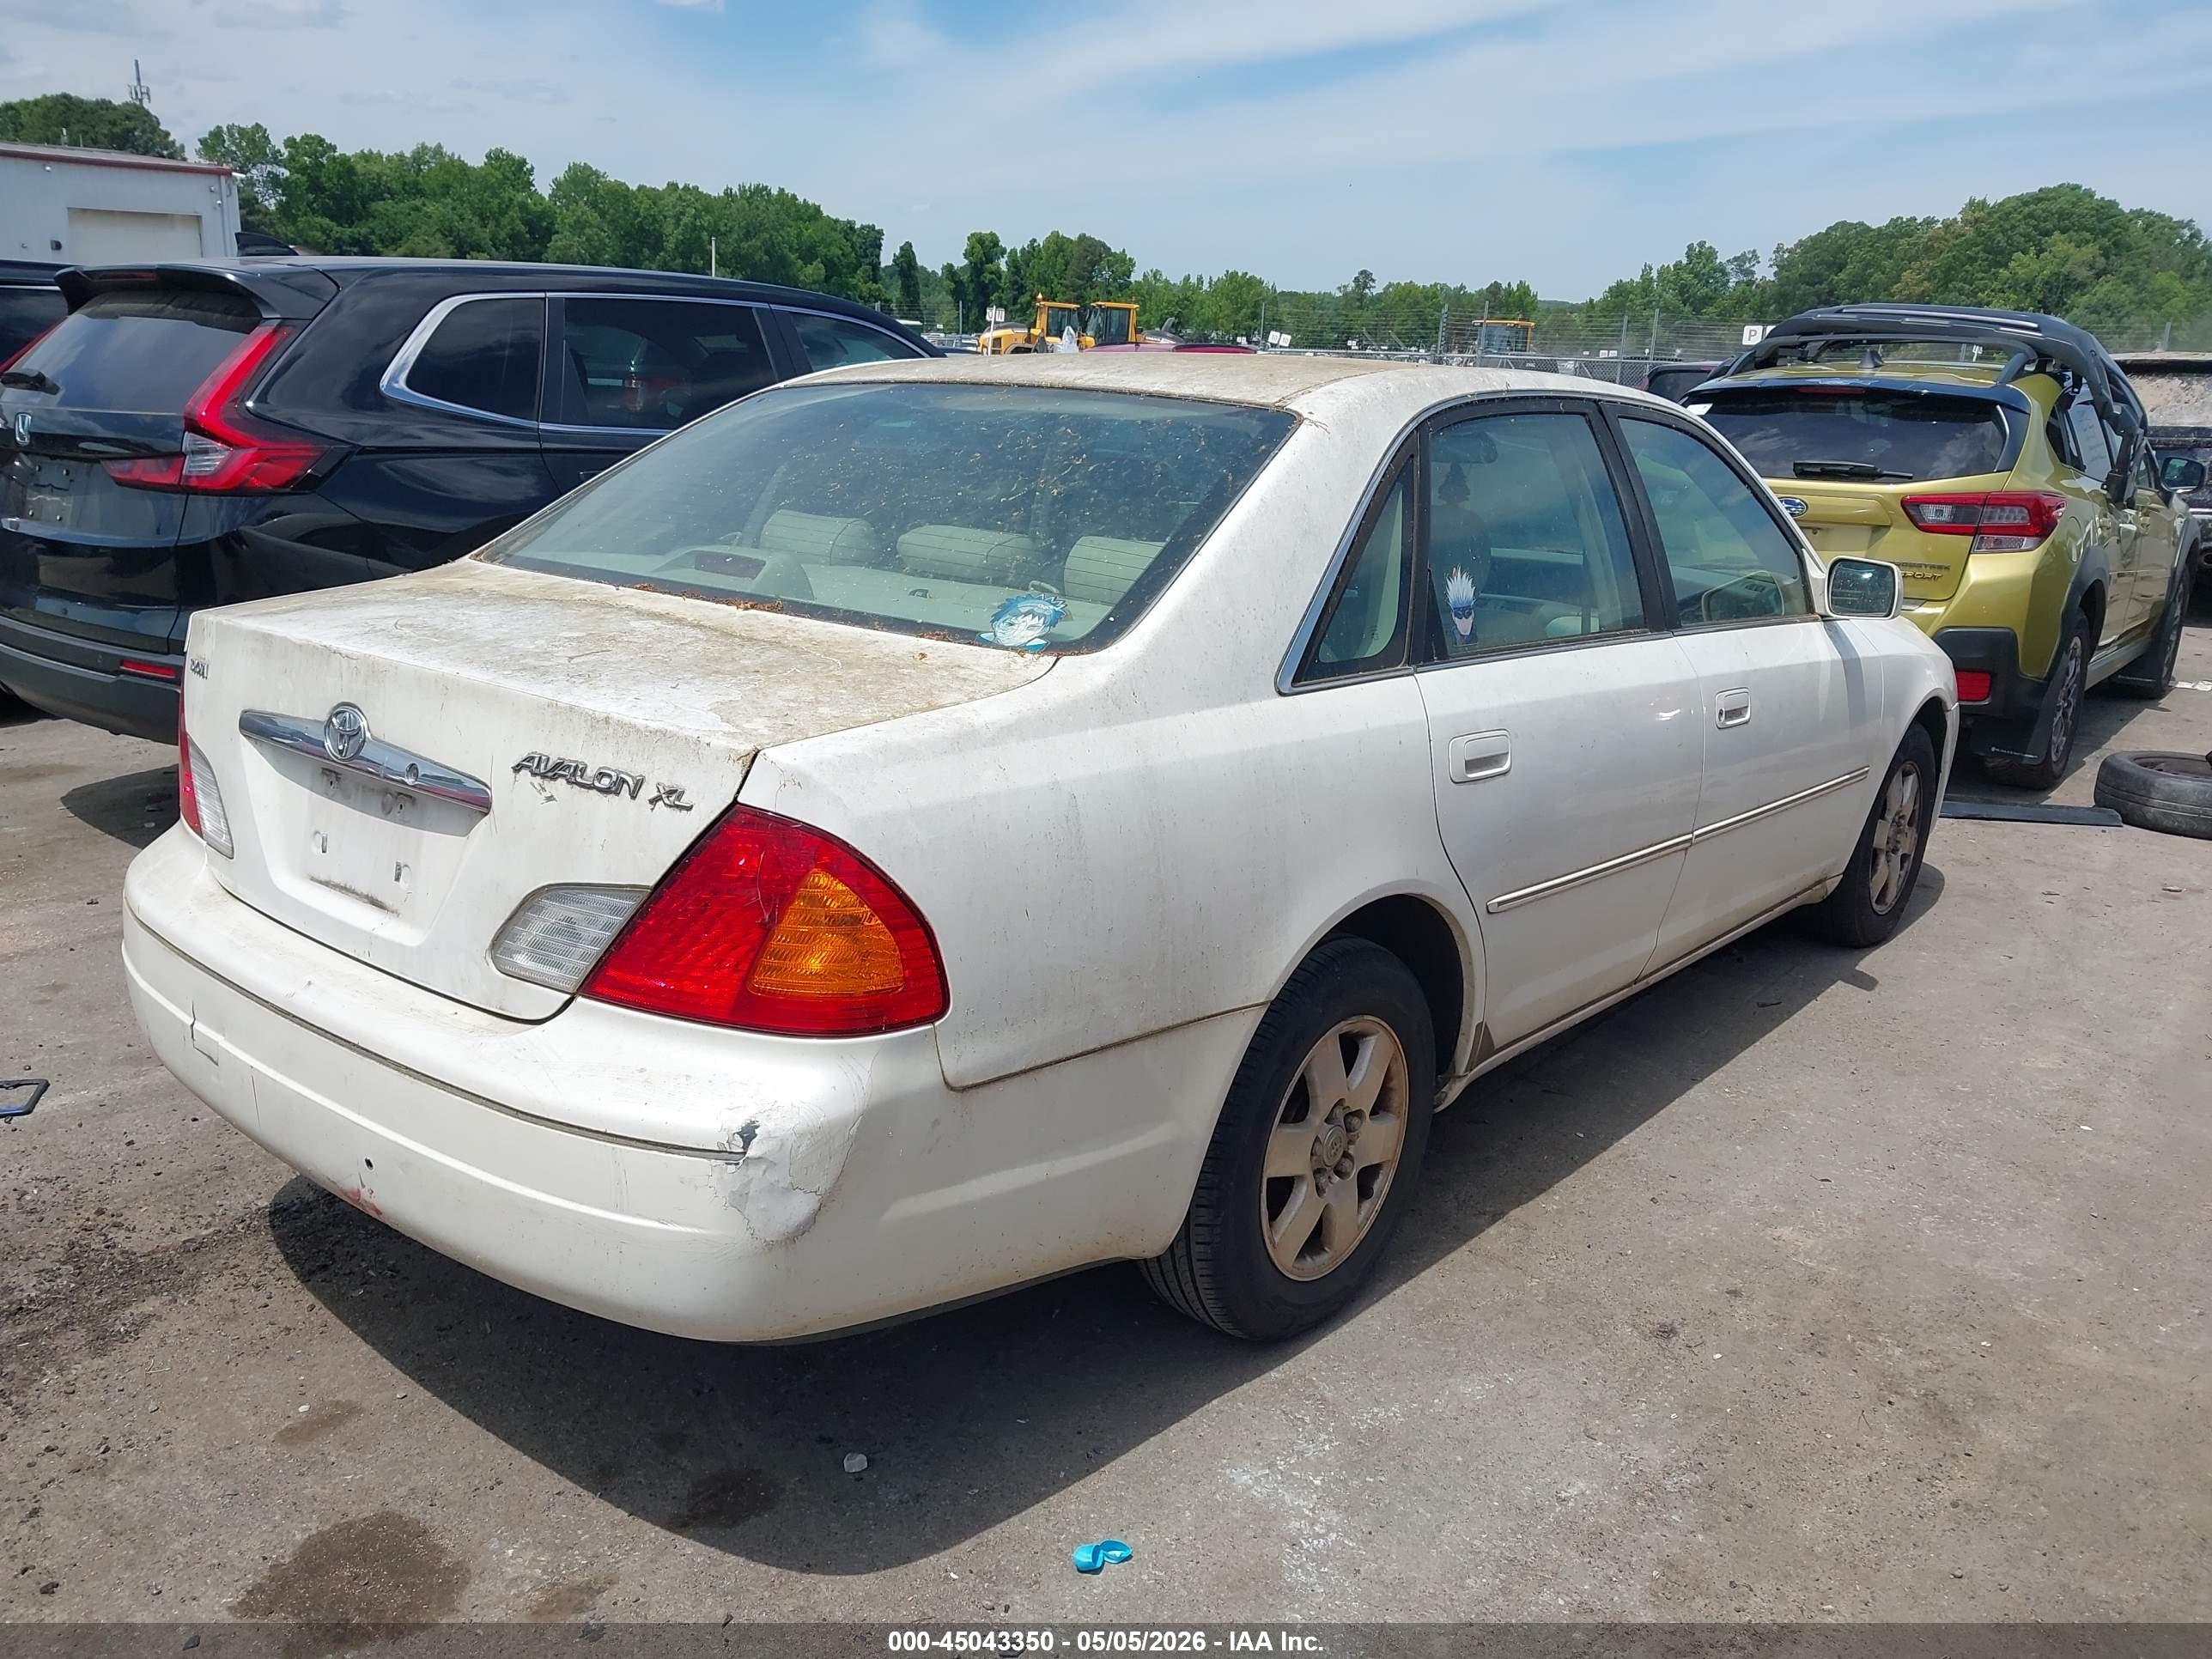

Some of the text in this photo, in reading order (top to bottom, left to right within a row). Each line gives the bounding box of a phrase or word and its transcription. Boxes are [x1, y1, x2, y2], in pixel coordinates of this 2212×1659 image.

[1747, 329, 1758, 342] P
[511, 751, 694, 811] AVALON XL
